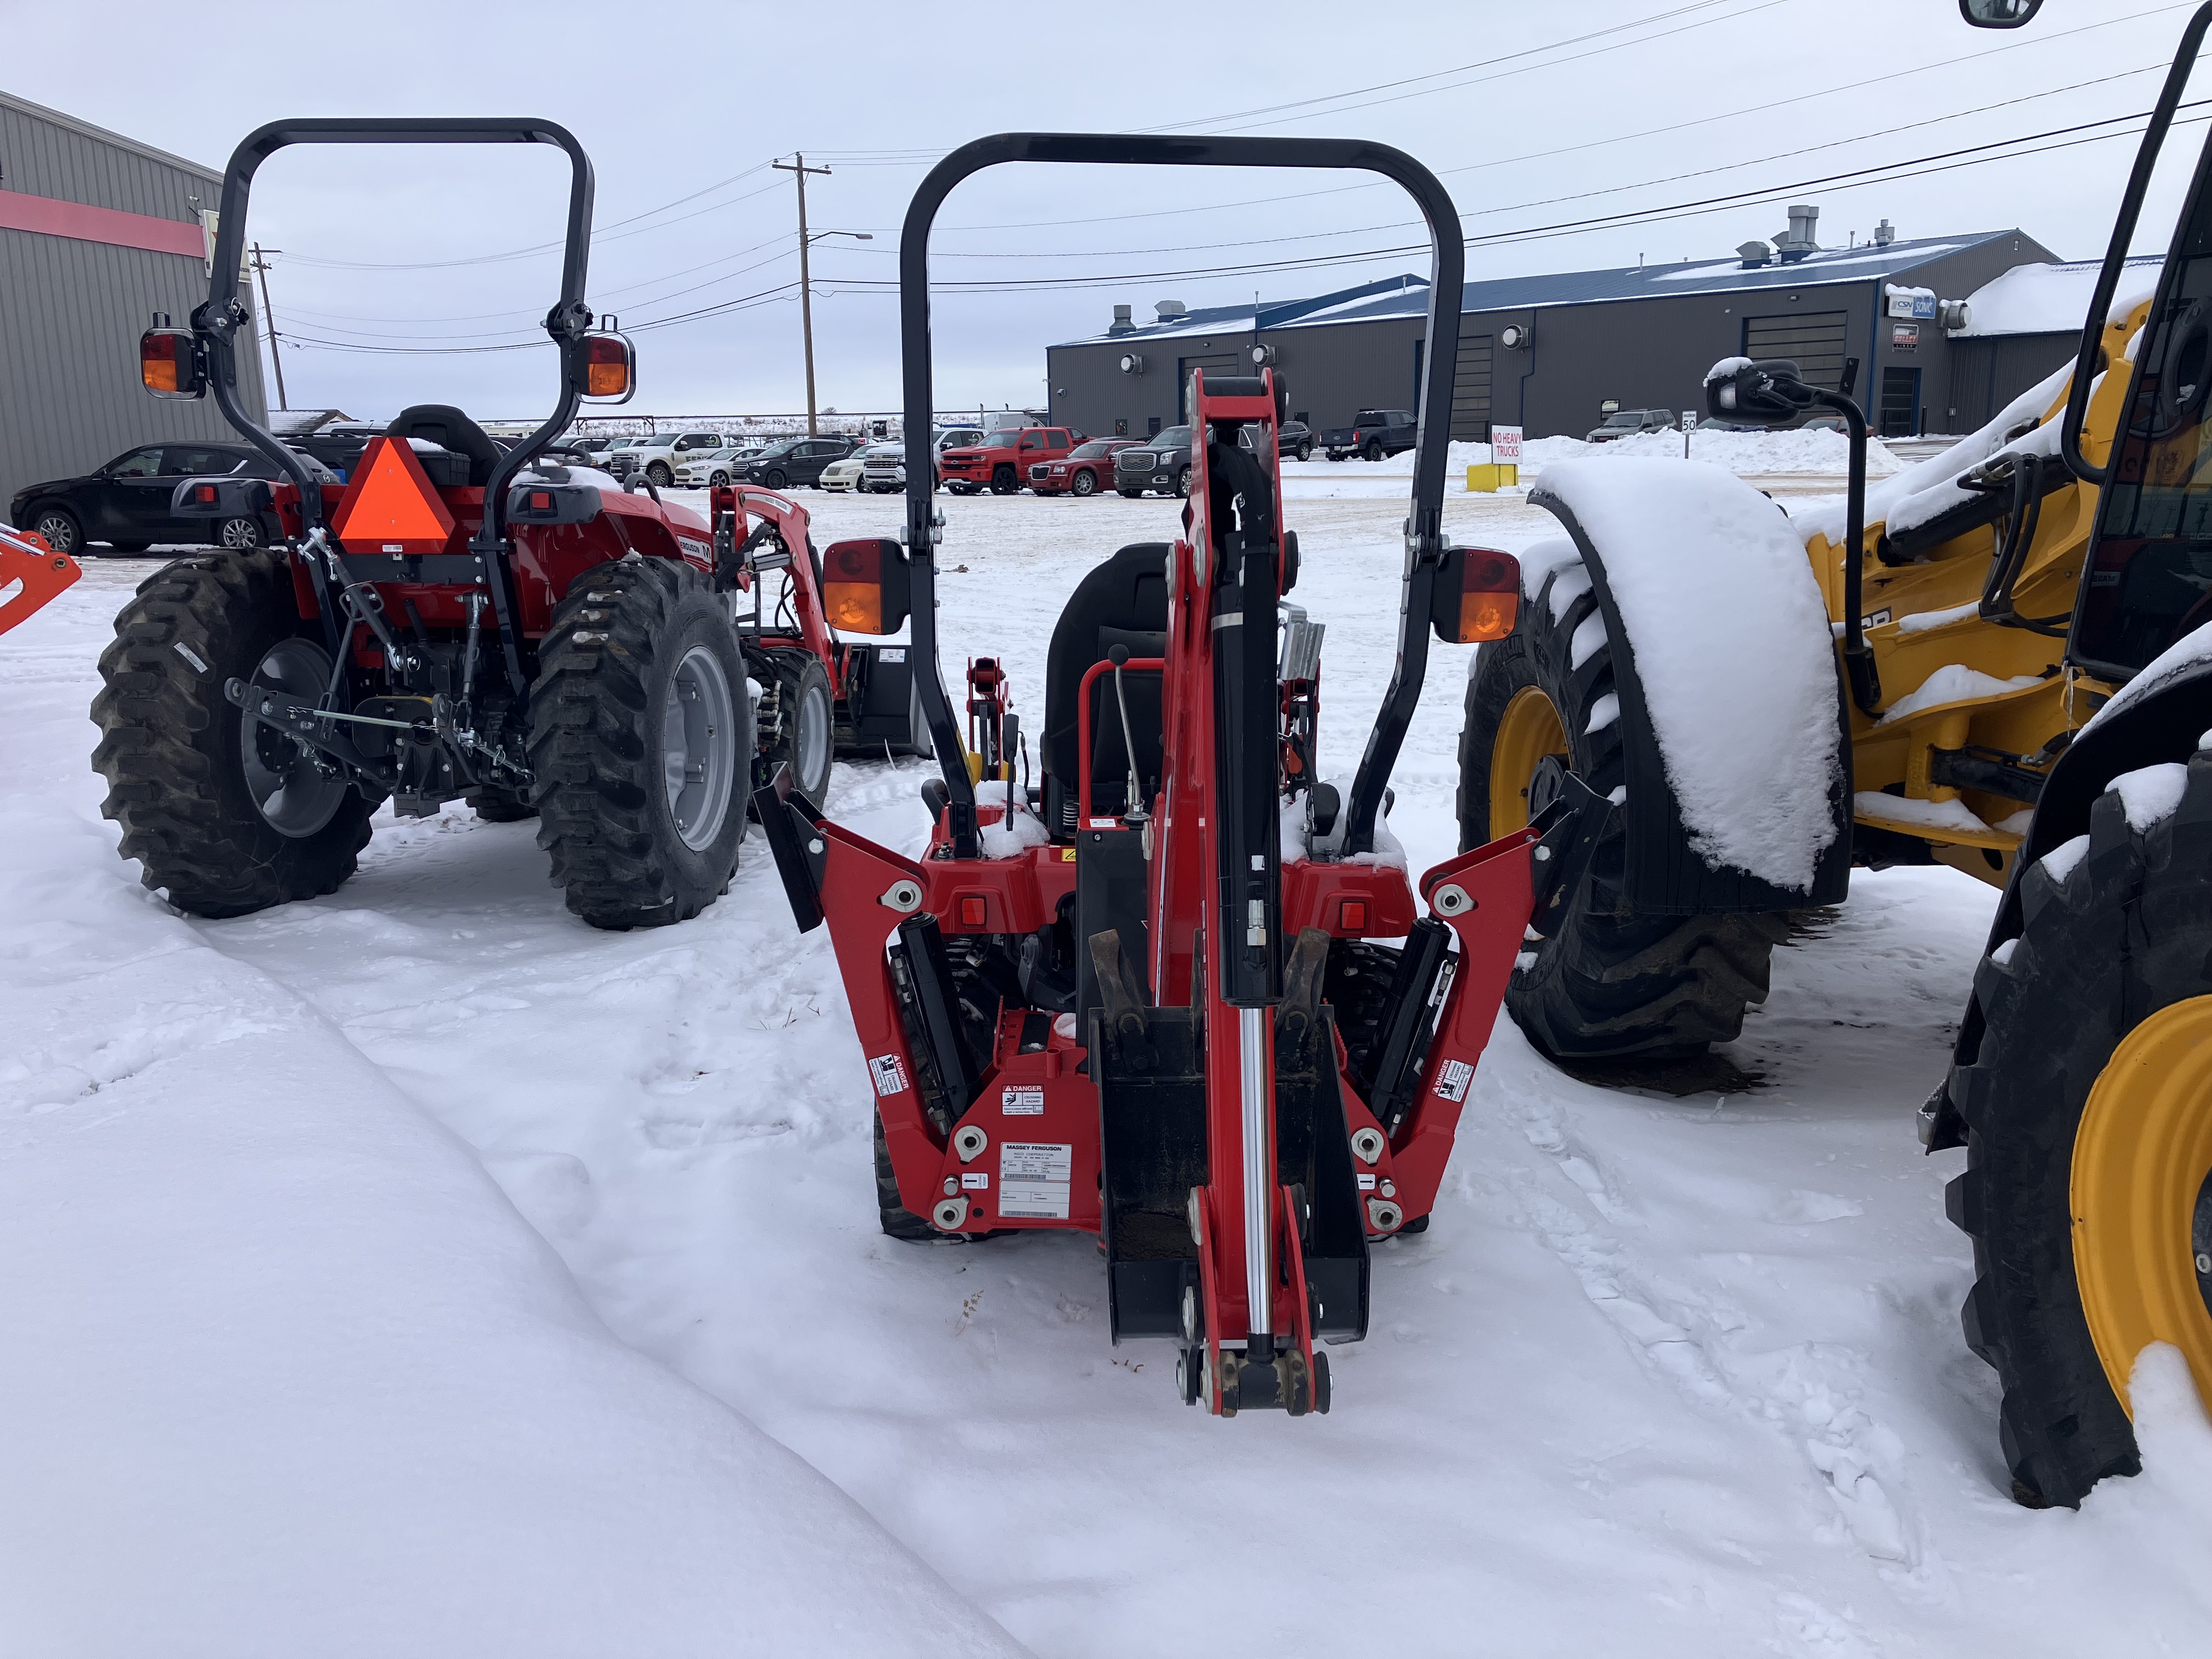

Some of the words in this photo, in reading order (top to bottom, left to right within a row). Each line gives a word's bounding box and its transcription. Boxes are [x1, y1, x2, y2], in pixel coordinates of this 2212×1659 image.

[1915, 302, 1932, 313] SONIC
[1683, 420, 1695, 431] 50
[1493, 432, 1502, 443] NO
[1503, 432, 1521, 444] HEAVY
[1497, 445, 1519, 456] TRUCKS
[680, 541, 699, 553] ERGUSON
[896, 1062, 909, 1088] DANGER
[1435, 1059, 1450, 1086] DANGER
